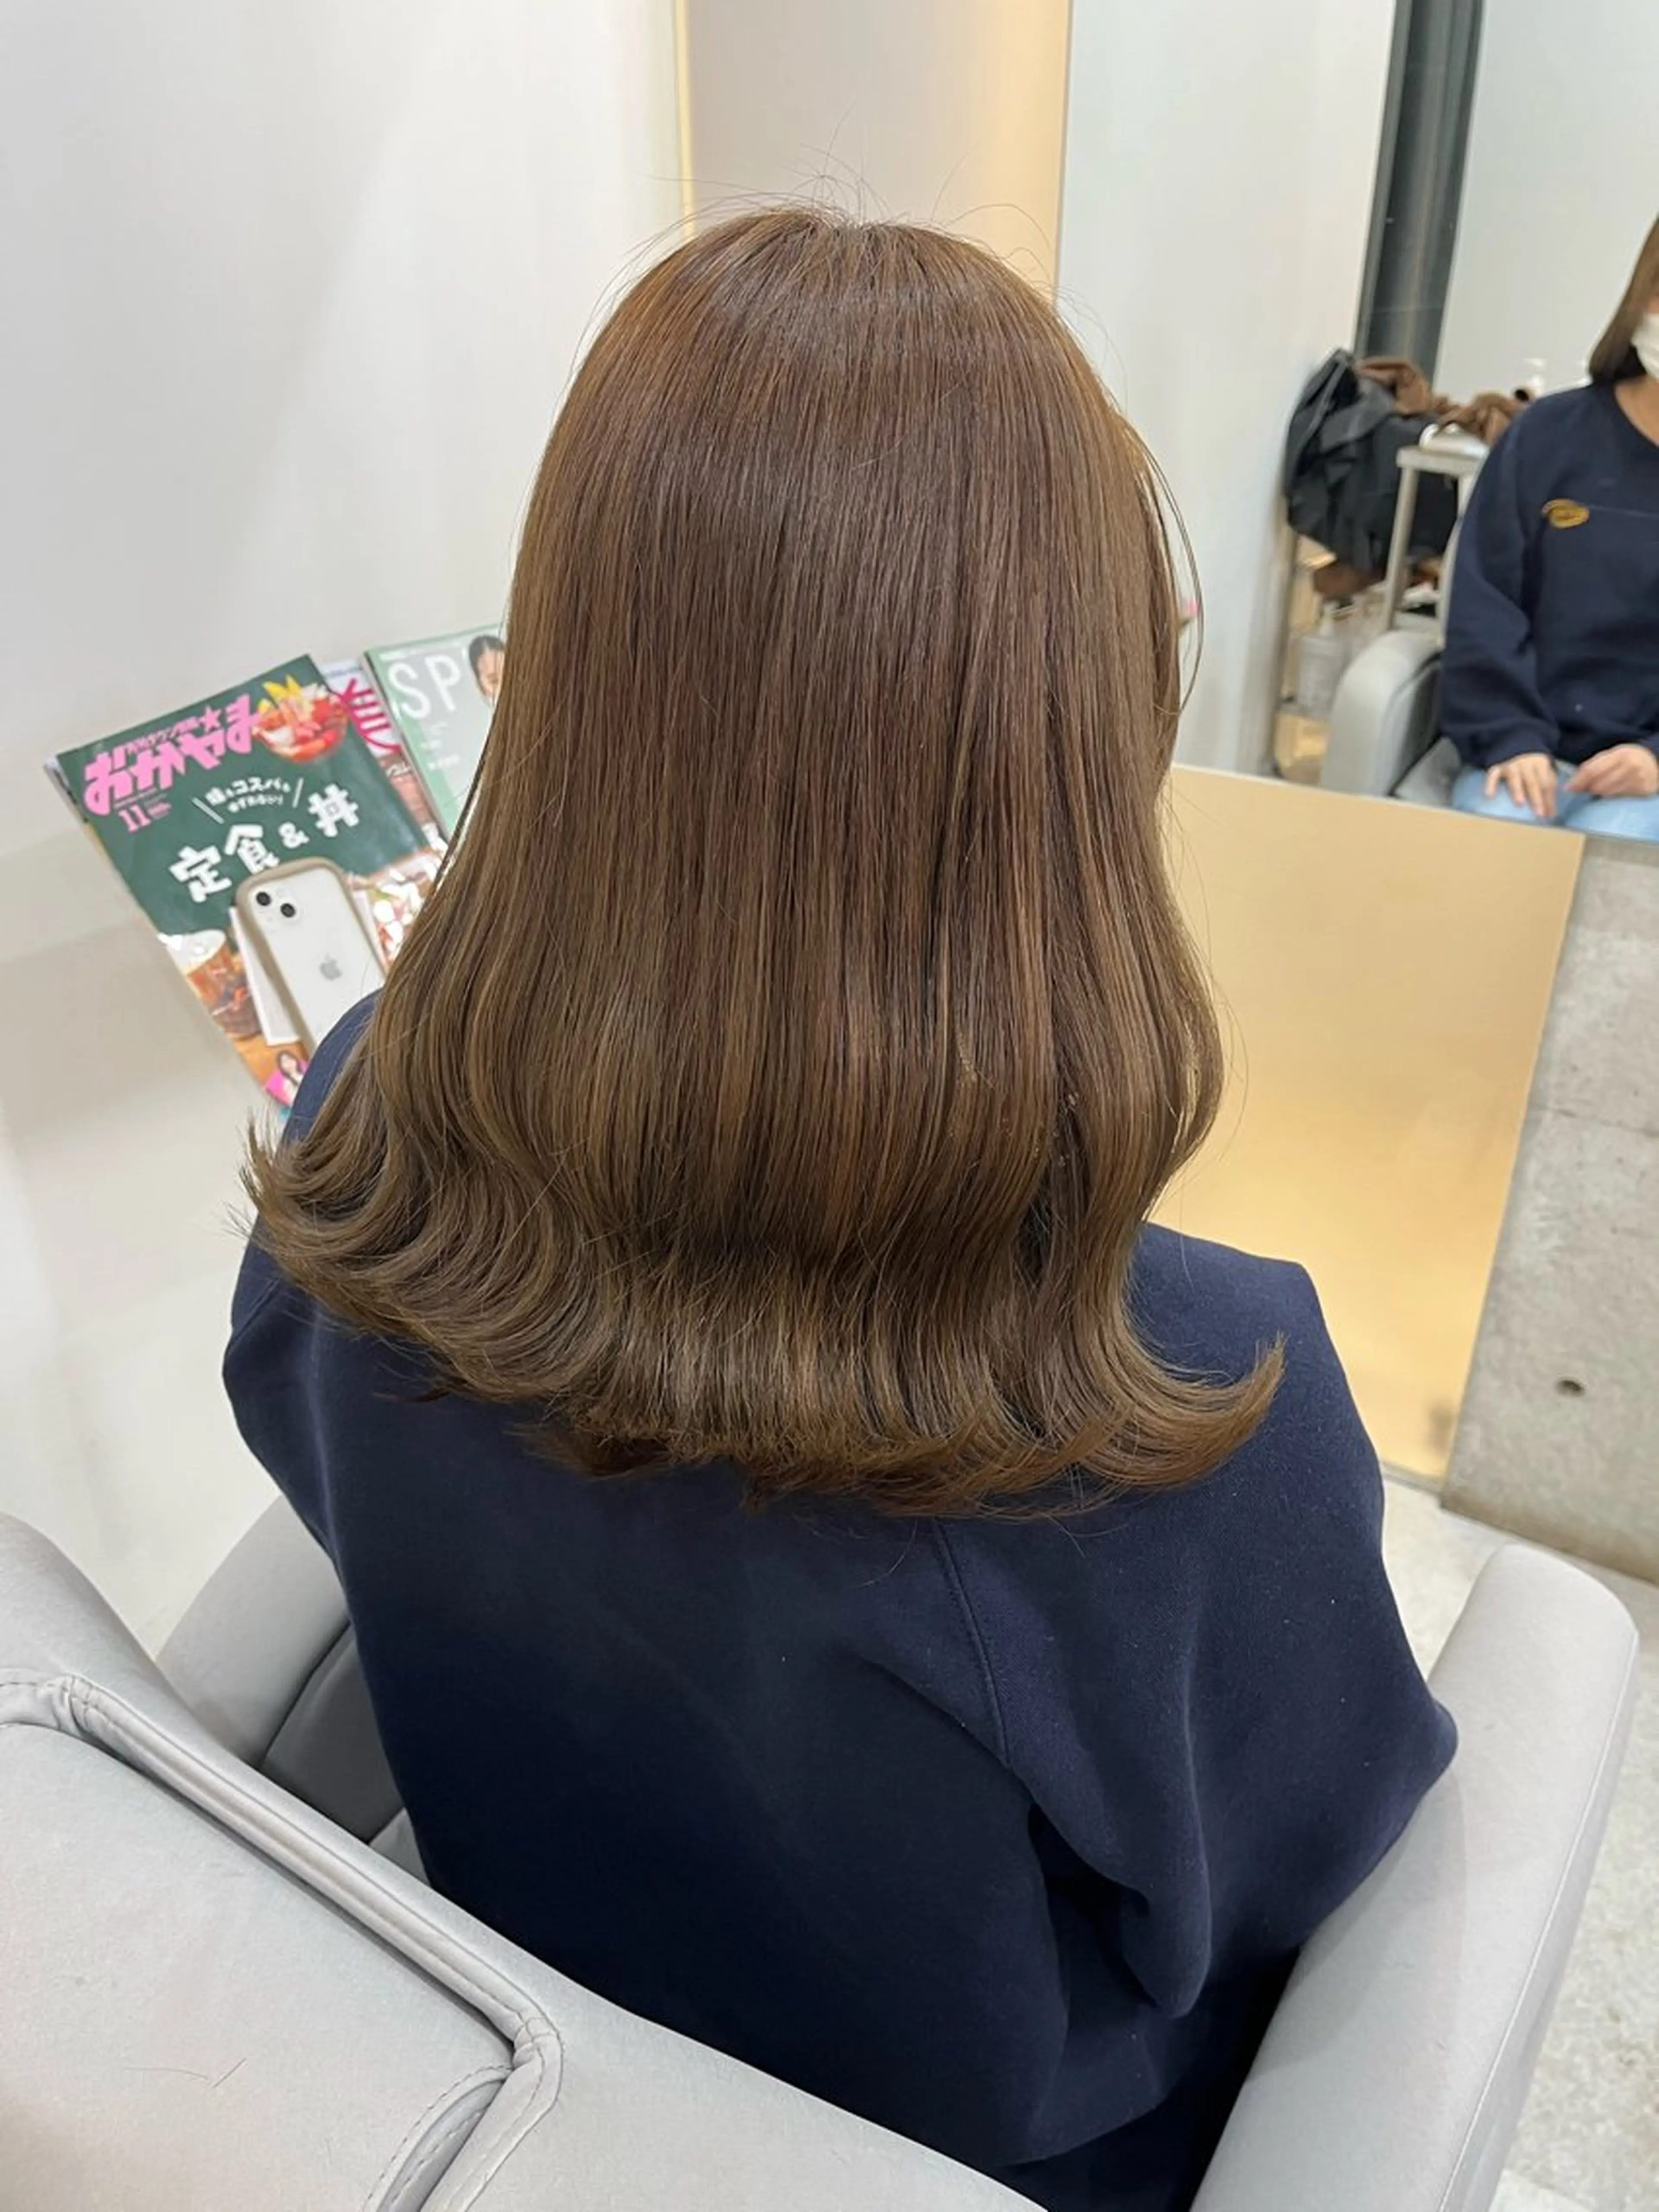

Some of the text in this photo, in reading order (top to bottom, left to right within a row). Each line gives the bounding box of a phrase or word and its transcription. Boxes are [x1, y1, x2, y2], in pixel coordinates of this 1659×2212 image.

[83, 693, 261, 816] おかやま
[118, 804, 152, 832] 11
